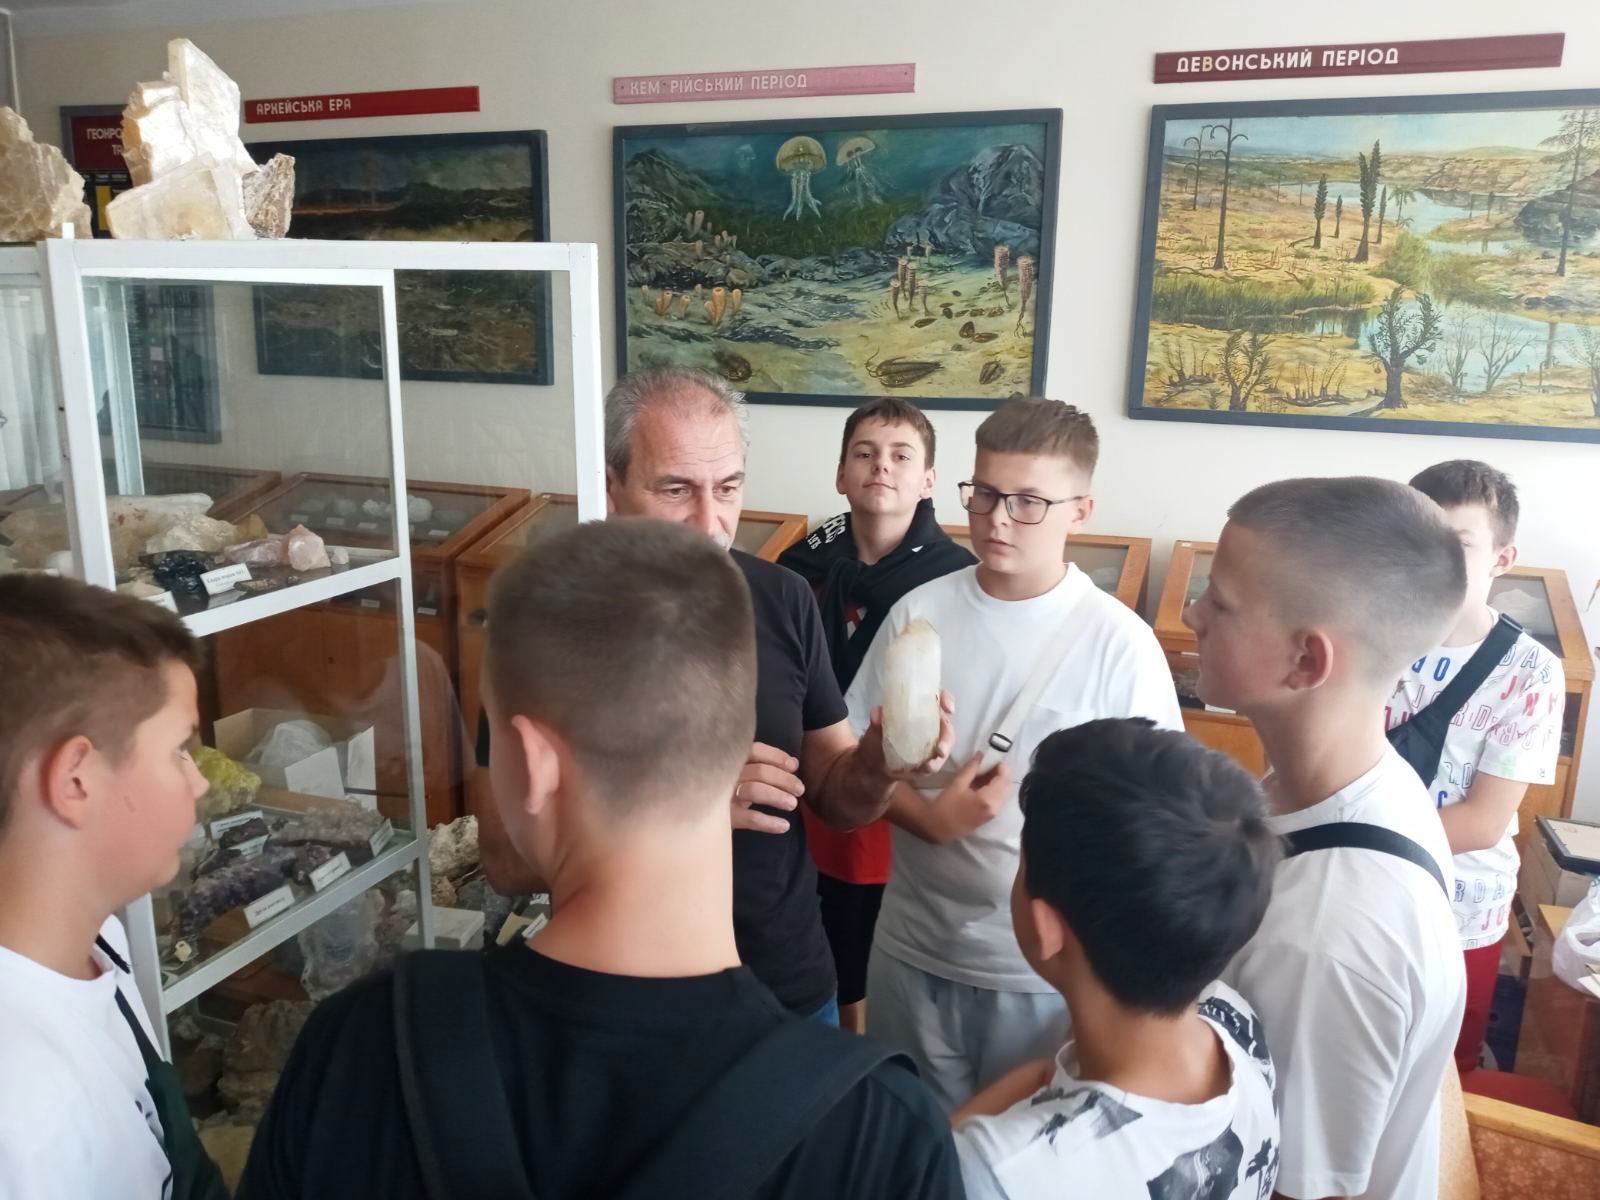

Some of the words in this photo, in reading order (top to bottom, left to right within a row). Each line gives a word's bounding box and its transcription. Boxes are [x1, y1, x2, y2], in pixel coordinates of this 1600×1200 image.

[1176, 49, 1312, 73] ДЕВОНСЬКИЙ
[1322, 48, 1399, 67] ПЕРІОД
[751, 74, 807, 90] ПЕРІОД
[329, 98, 352, 111] ЕРА
